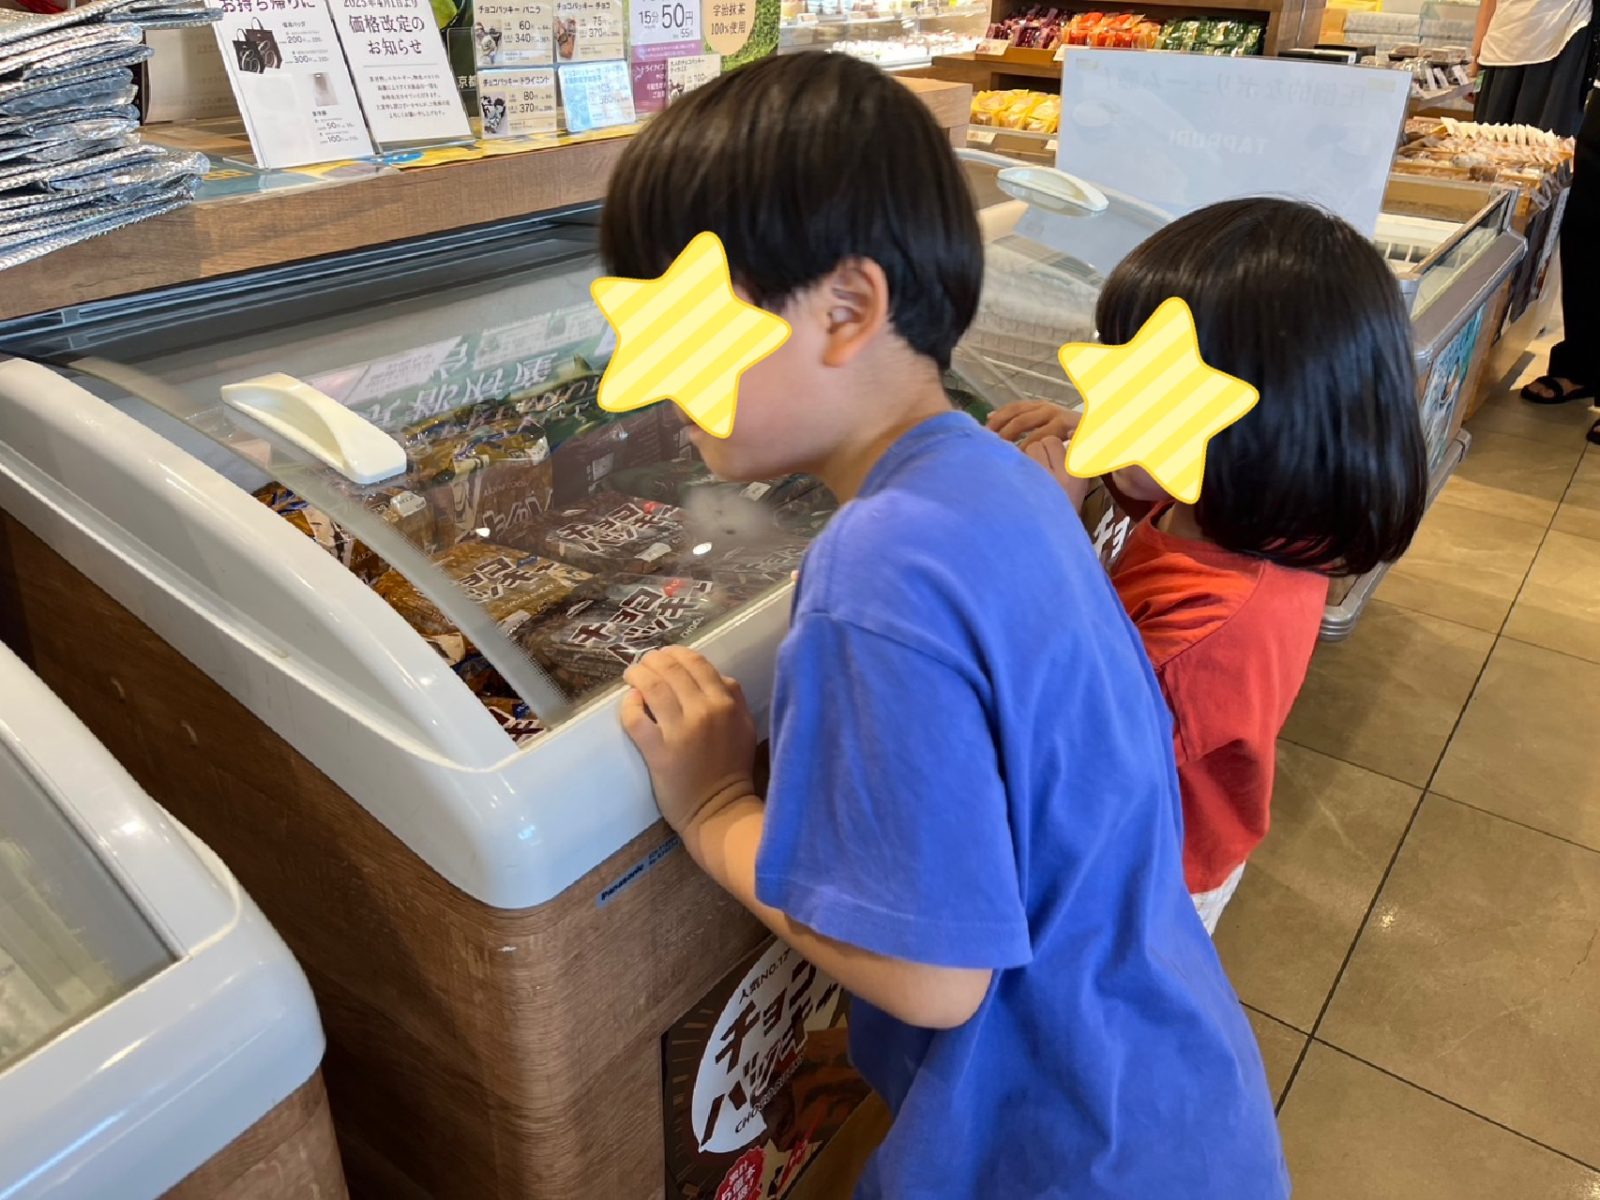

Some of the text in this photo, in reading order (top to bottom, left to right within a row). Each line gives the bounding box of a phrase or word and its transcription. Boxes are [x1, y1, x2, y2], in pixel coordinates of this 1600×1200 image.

[478, 5, 541, 14] チョコバッキー バニラ
[662, 3, 694, 29] 50円
[713, 3, 746, 17] 宇治抹茶
[349, 15, 425, 33] 価格改定の
[711, 21, 747, 35] 100%使用
[368, 38, 422, 55] お知らせ
[483, 78, 518, 87] チョコバッキー
[568, 586, 665, 645] チョコ
[715, 958, 817, 1075] チョコ
